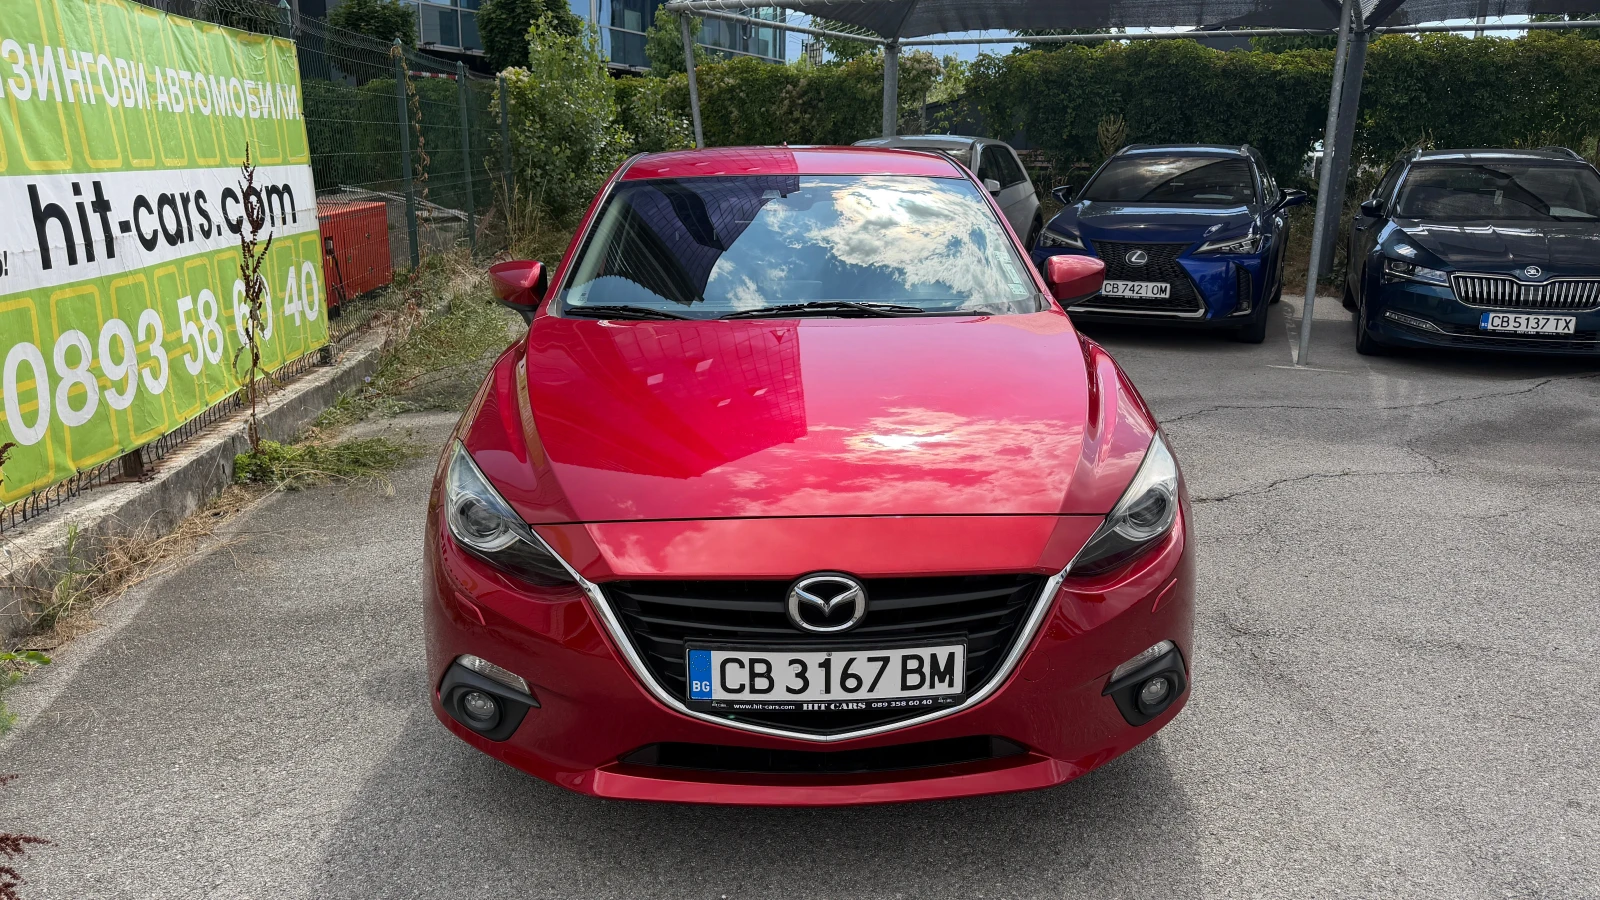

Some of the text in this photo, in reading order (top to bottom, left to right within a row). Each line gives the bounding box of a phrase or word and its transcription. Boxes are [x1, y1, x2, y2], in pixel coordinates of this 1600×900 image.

[0, 38, 299, 120] ЗИНГОВИ АВТОМОБИЛИ
[27, 180, 297, 270] hit-cars.com
[1104, 283, 1168, 296] CB 7421 OM
[1491, 315, 1573, 331] CB 5137 TX
[3, 261, 319, 446] 0893 58 60 40
[692, 681, 710, 692] BG
[719, 651, 956, 694] CB 3167 BM
[802, 703, 828, 711] HIT
[830, 702, 866, 710] CARS
